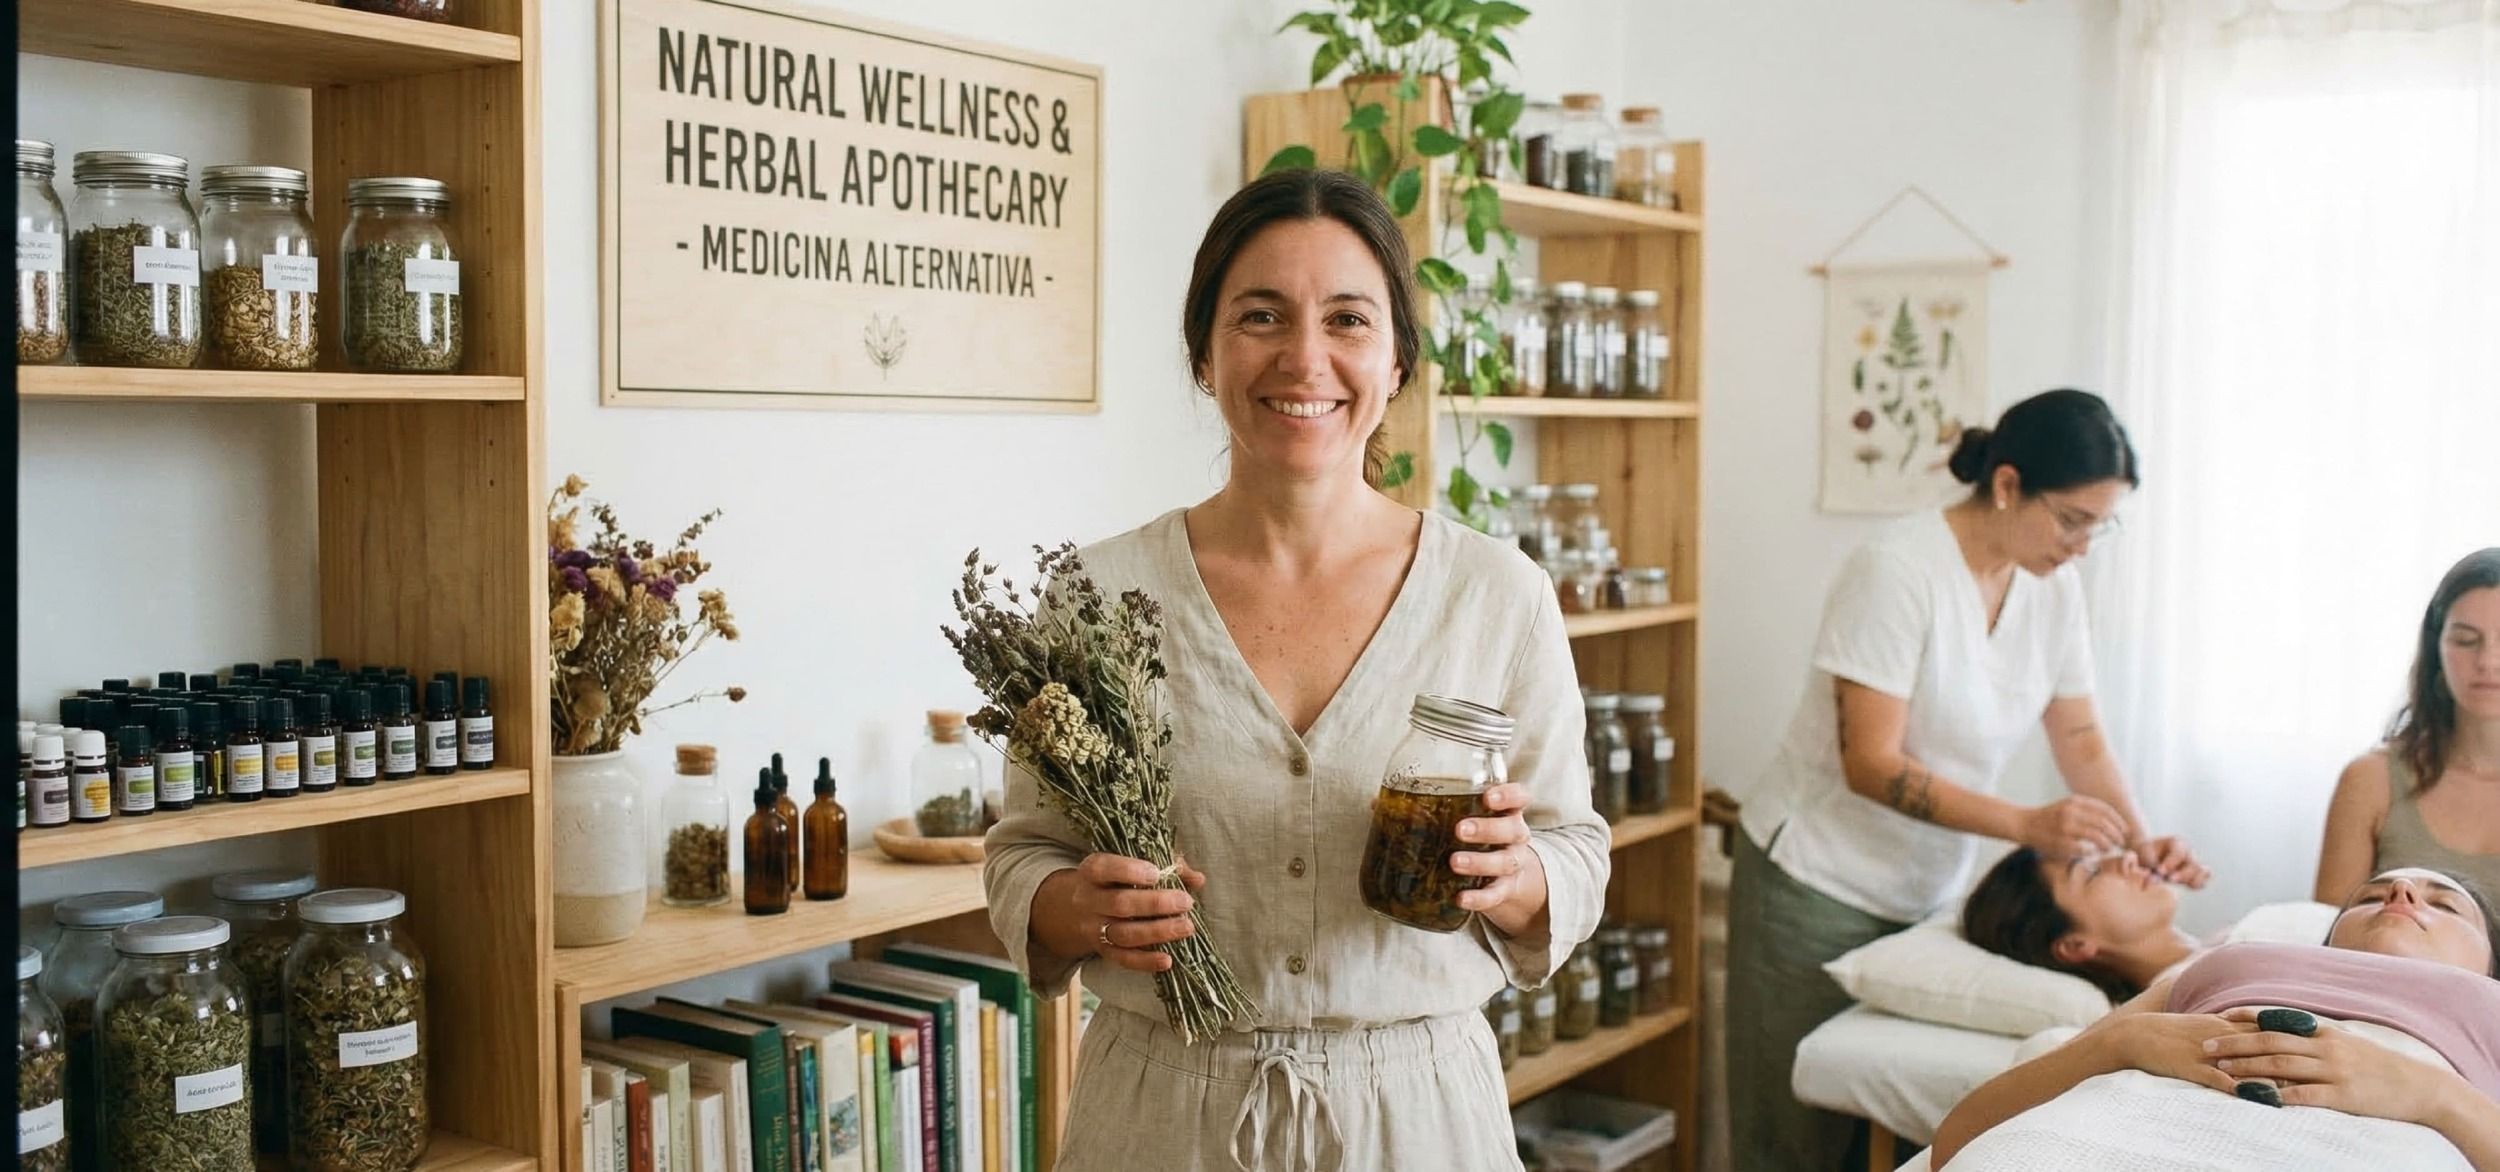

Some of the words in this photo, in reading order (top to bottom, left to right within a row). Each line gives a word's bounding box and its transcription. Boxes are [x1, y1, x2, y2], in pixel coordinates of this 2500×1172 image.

[658, 26, 847, 119] NATURAL
[859, 63, 1041, 150] WELLNESS
[1051, 98, 1073, 155] &
[665, 119, 828, 201] HERBAL
[841, 145, 1069, 229] APOTHECARY
[702, 223, 853, 283] MEDICINA
[863, 240, 1035, 298] ALTERNATIVA
